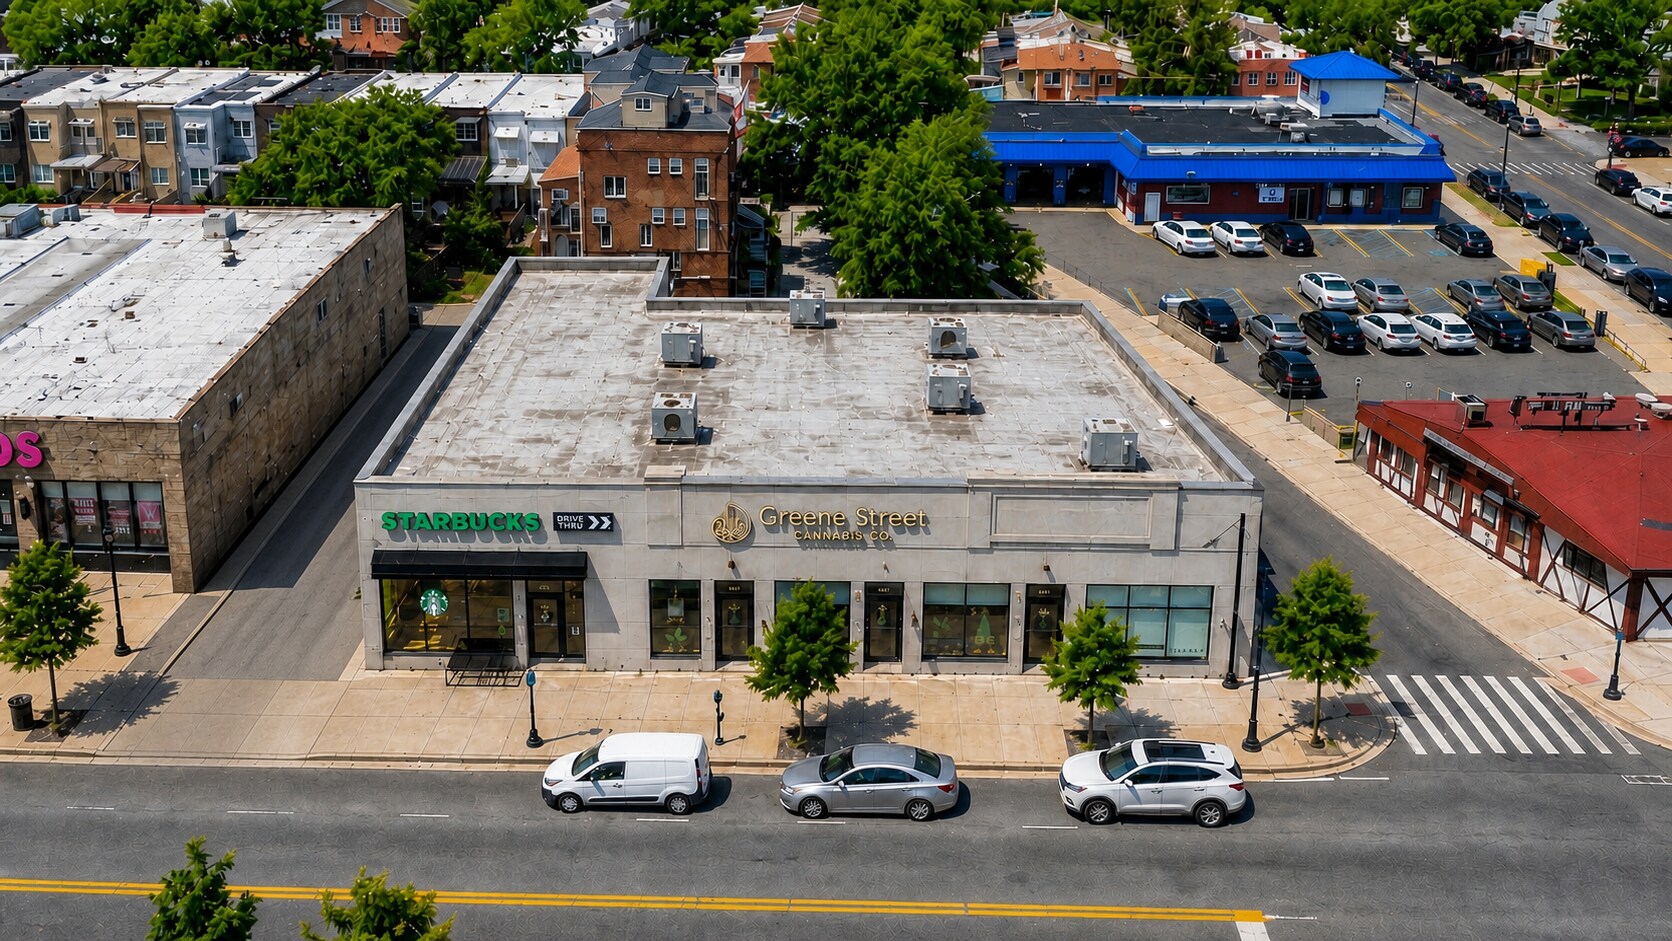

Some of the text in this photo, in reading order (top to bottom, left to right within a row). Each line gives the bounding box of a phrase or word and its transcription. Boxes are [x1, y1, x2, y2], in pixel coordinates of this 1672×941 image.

[381, 511, 541, 532] STARBUCKS
[556, 515, 584, 523] DRIVE
[759, 505, 928, 528] Greene Street
[557, 522, 583, 530] THRU
[794, 530, 893, 541] CANNABIS CO.
